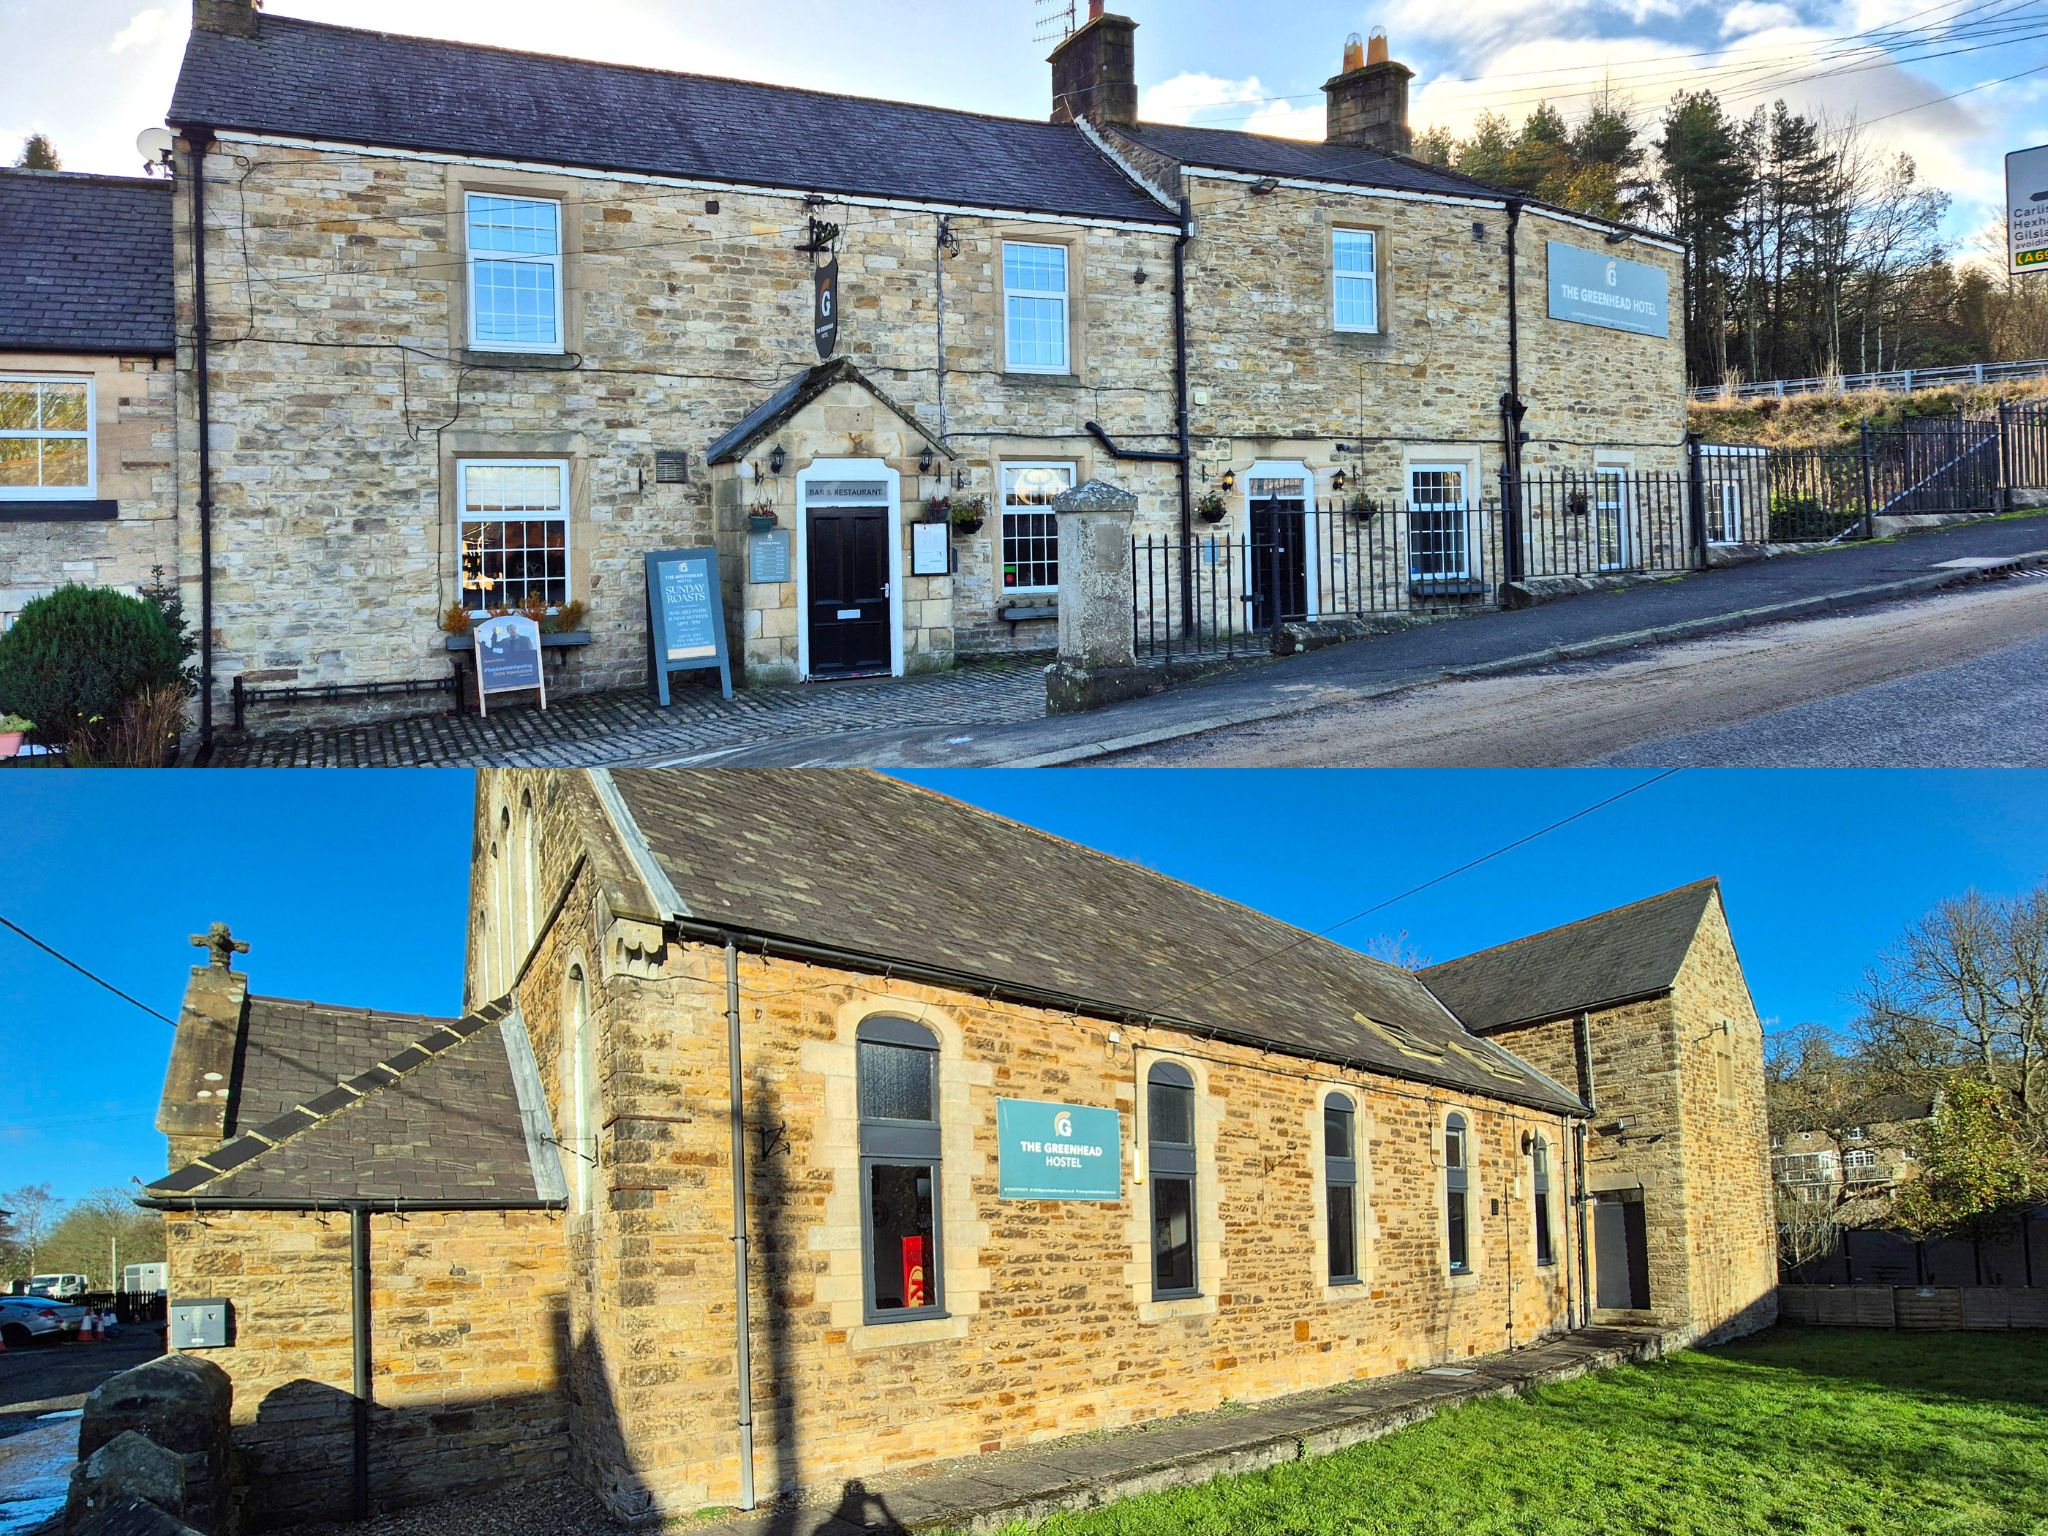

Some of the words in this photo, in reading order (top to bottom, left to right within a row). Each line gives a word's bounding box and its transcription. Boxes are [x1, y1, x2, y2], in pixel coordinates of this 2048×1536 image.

[2014, 216, 2048, 230] Hexh
[822, 290, 831, 317] G
[1561, 284, 1579, 300] THE
[1581, 289, 1631, 310] GREENHEAD
[1634, 299, 1658, 316] HOTEL
[834, 488, 882, 496] RESTAURANT
[665, 584, 704, 595] SUNDAY
[667, 592, 706, 604] ROASTS
[1021, 1141, 1041, 1152] THE
[1044, 1143, 1103, 1157] GREENHEAD
[1045, 1156, 1082, 1168] HOSTEL
